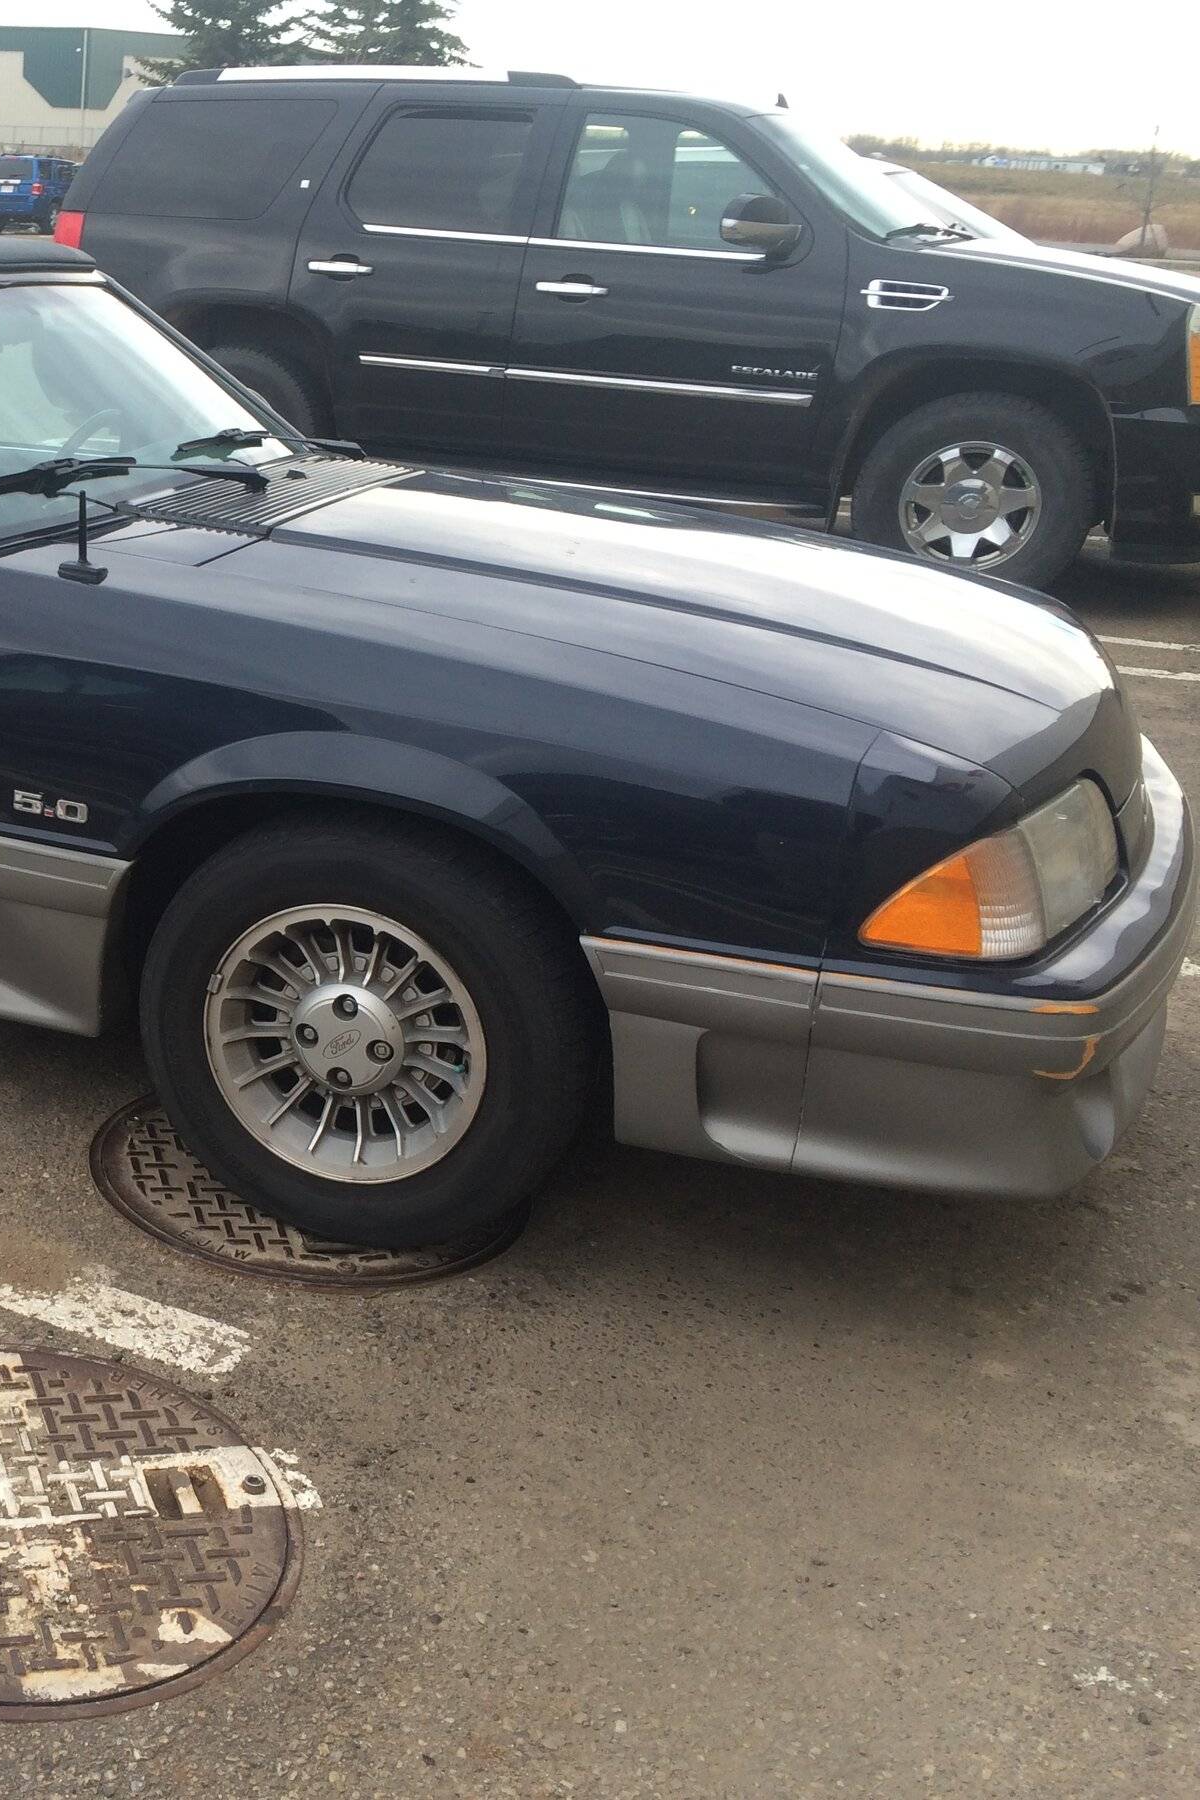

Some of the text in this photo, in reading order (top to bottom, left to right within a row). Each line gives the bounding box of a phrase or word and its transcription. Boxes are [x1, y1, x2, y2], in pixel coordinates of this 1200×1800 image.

[731, 365, 818, 380] ESCALADE
[13, 789, 88, 824] 5.0
[329, 1033, 355, 1055] Ford
